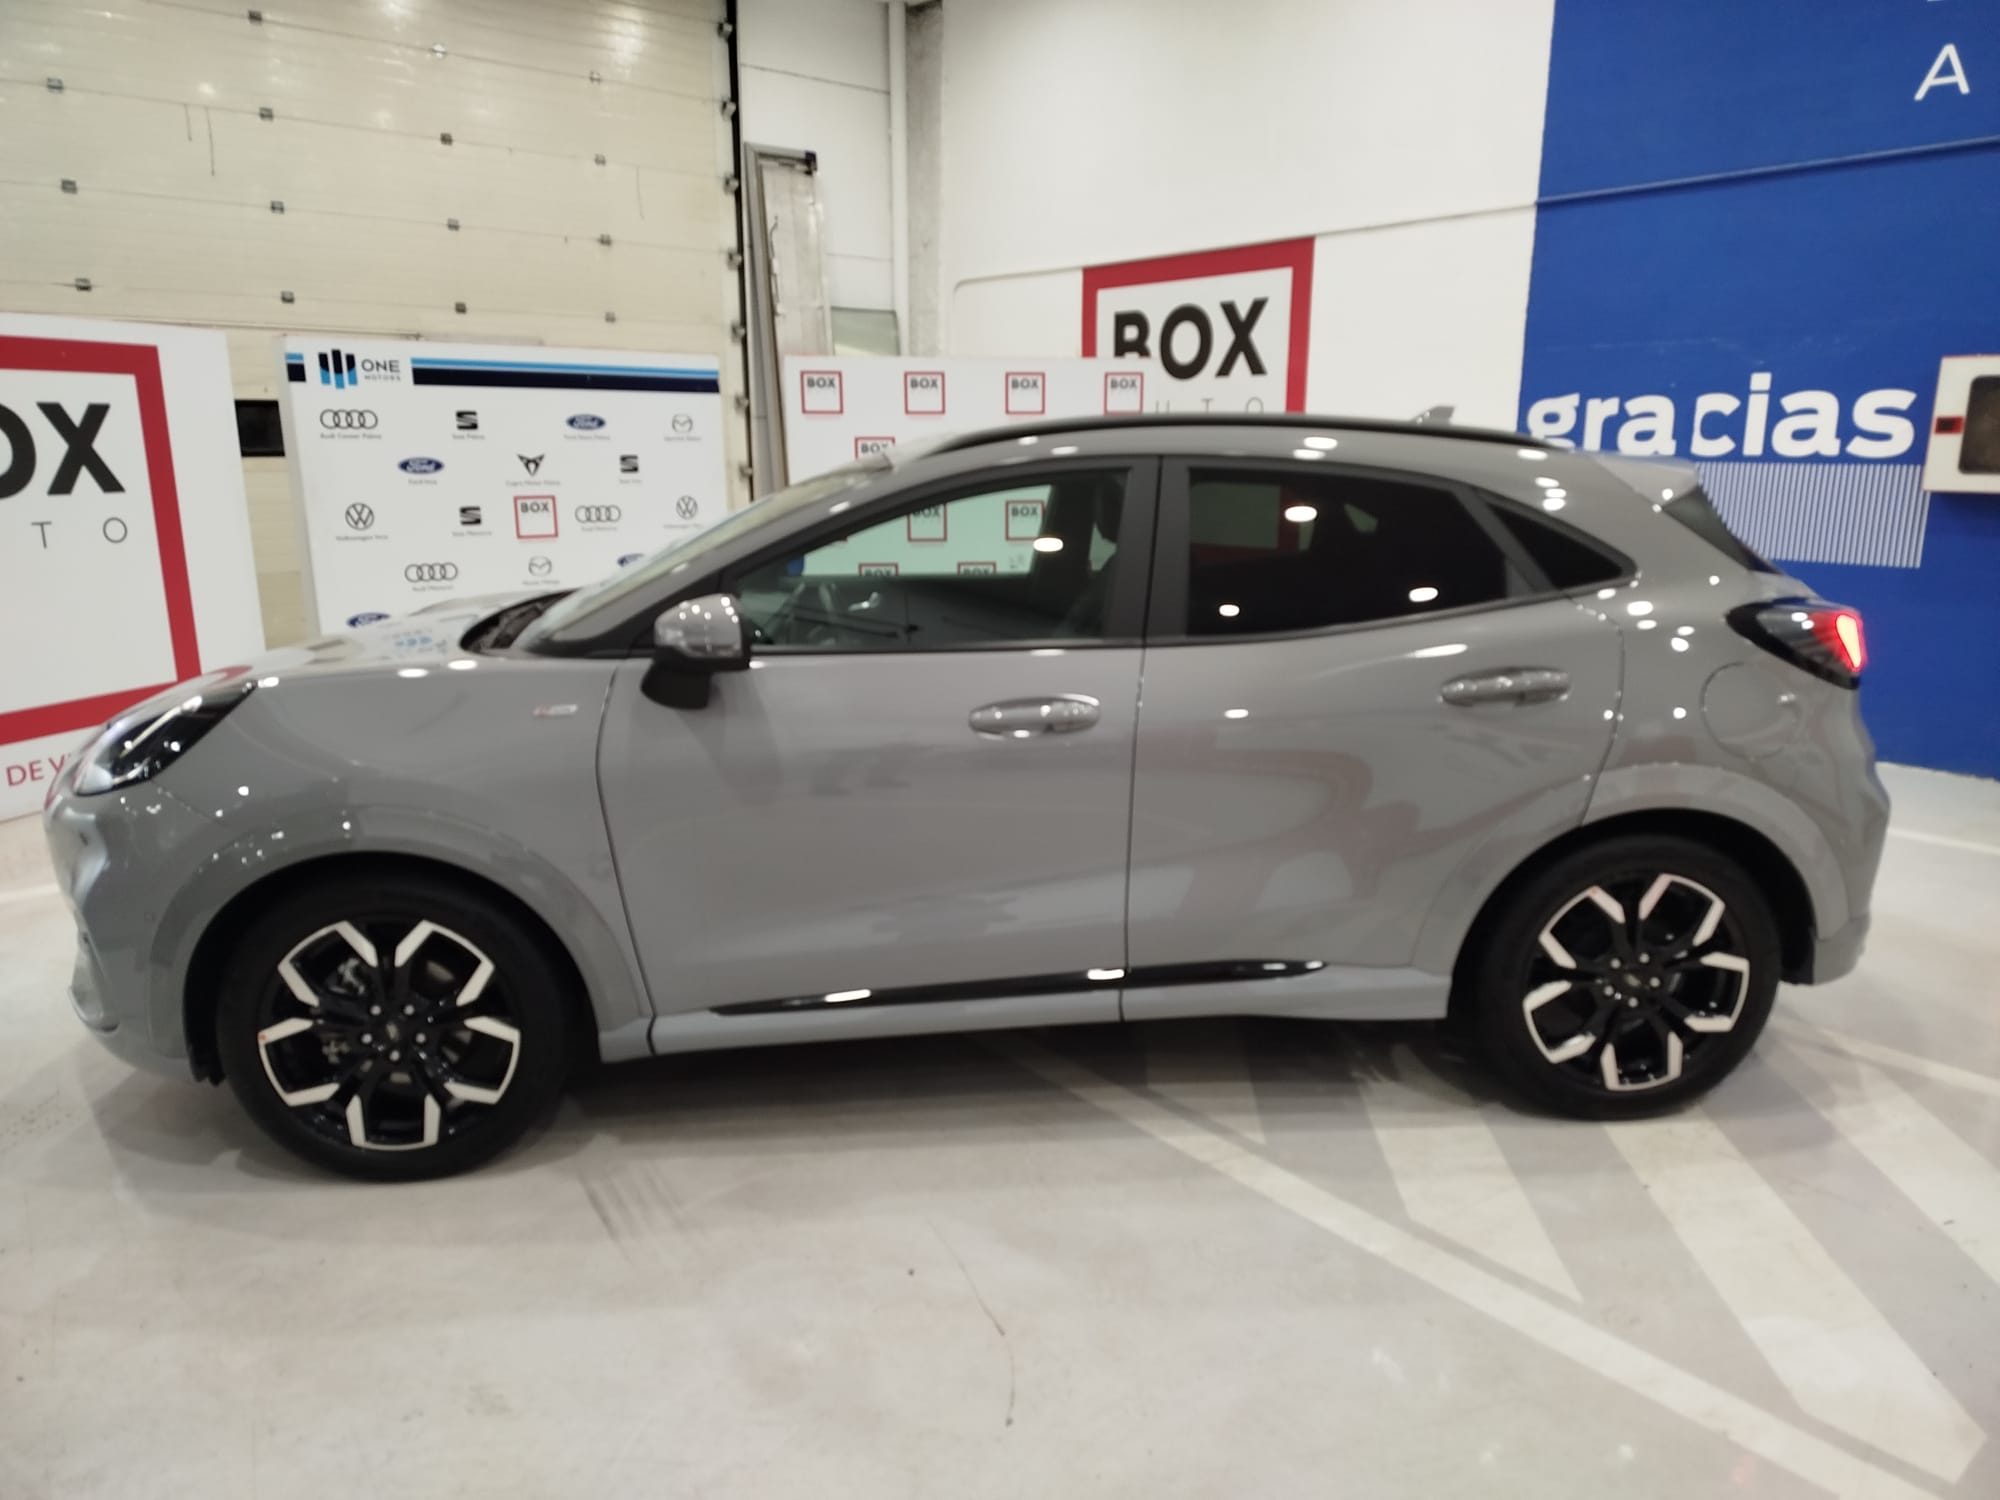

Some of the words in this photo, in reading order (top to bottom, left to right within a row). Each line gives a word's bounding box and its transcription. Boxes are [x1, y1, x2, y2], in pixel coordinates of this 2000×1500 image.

[1914, 43, 1970, 101] A
[1113, 297, 1269, 381] BOX
[361, 359, 401, 373] ONE
[806, 377, 835, 389] BOX
[910, 378, 938, 389] BOX
[1011, 378, 1039, 389] BOX
[1110, 379, 1137, 389] BOX
[1527, 372, 1917, 458] gracias
[520, 502, 550, 513] BOX
[1011, 505, 1038, 517] BOX
[7, 759, 44, 787] DE
